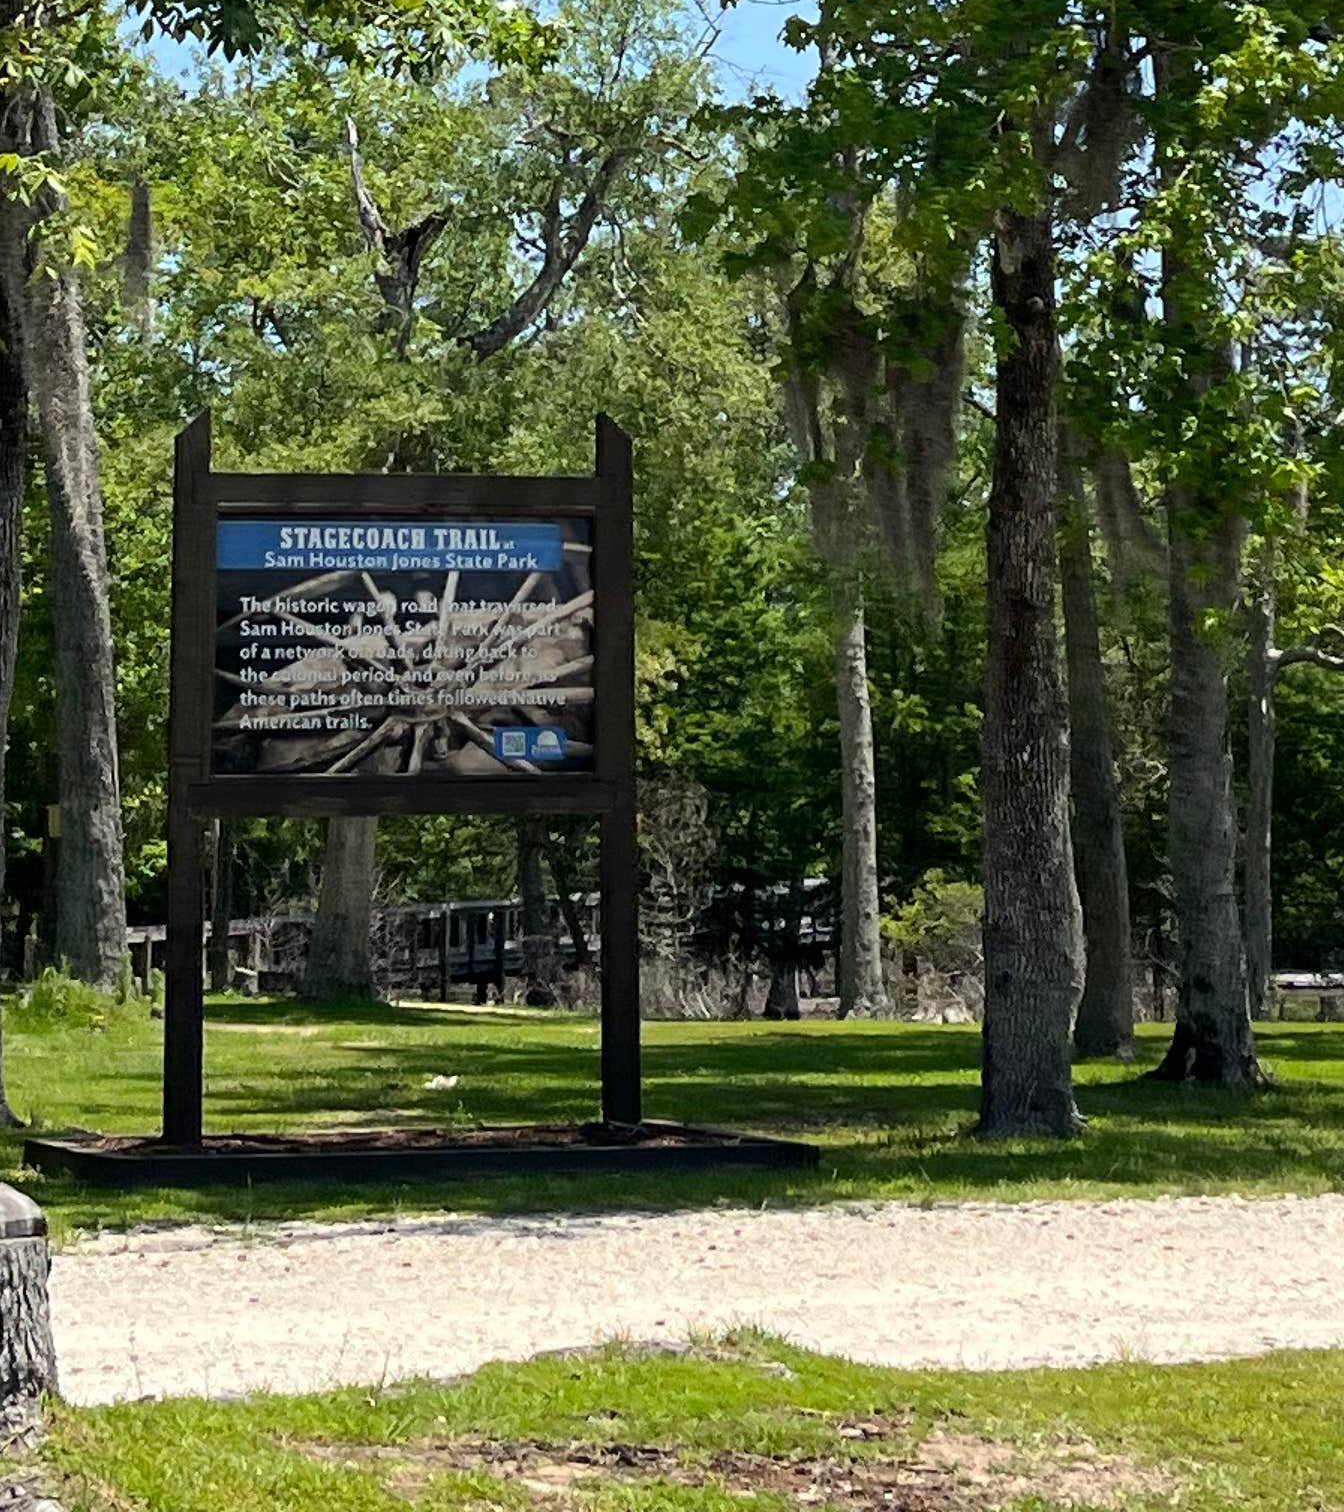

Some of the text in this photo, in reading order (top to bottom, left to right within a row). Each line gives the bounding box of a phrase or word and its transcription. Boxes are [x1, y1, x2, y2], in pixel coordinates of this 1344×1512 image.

[280, 527, 425, 550] STAGECOACH
[433, 528, 500, 550] TRAIL
[264, 551, 538, 571] Sam Houston Jones State Park
[240, 596, 271, 613] The
[276, 597, 339, 613] historic
[401, 598, 438, 613] road
[441, 598, 474, 613] hat
[240, 620, 277, 636] Sam
[281, 620, 352, 636] Houston
[406, 620, 446, 636] Stat
[240, 642, 259, 659] of
[261, 647, 271, 659] a
[275, 643, 344, 659] network
[368, 643, 419, 662] oads,
[240, 666, 268, 682] the
[404, 667, 433, 682] and
[240, 689, 286, 706] these
[290, 689, 335, 711] paths
[340, 689, 383, 705] often
[388, 689, 434, 705] times
[240, 713, 323, 729] American
